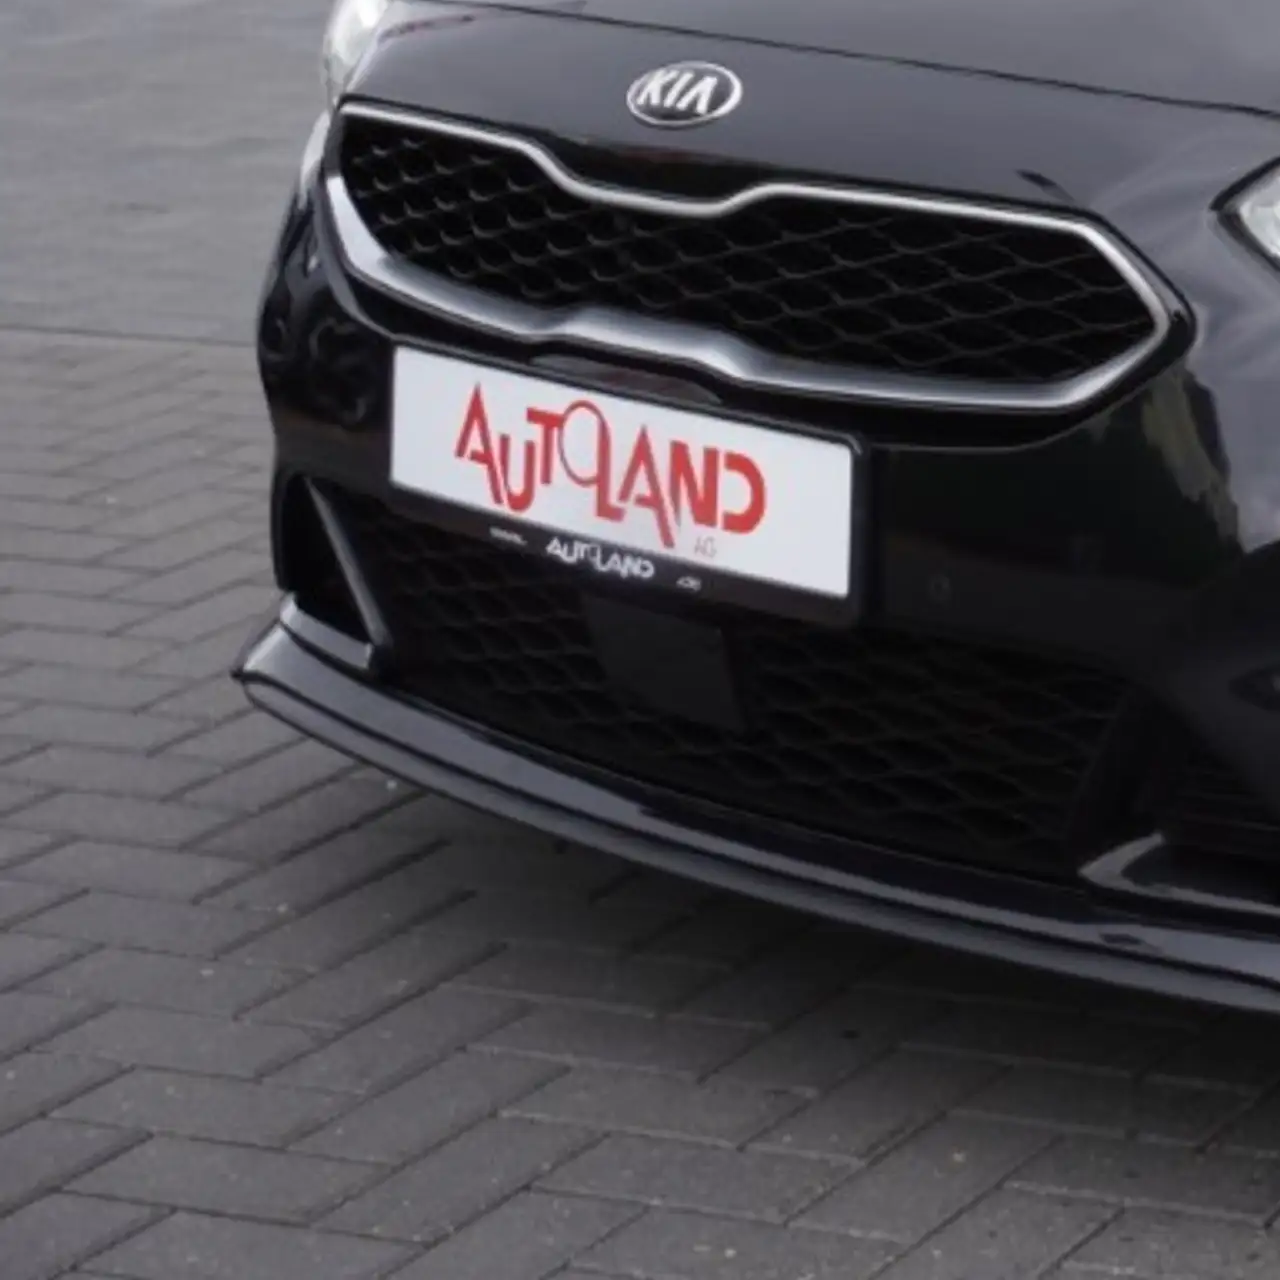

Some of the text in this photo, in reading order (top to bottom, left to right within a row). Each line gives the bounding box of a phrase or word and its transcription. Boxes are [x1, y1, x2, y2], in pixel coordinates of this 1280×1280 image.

[636, 68, 718, 115] KIA
[455, 383, 766, 549] AUTOLAND
[546, 536, 655, 579] AUTOLAND
